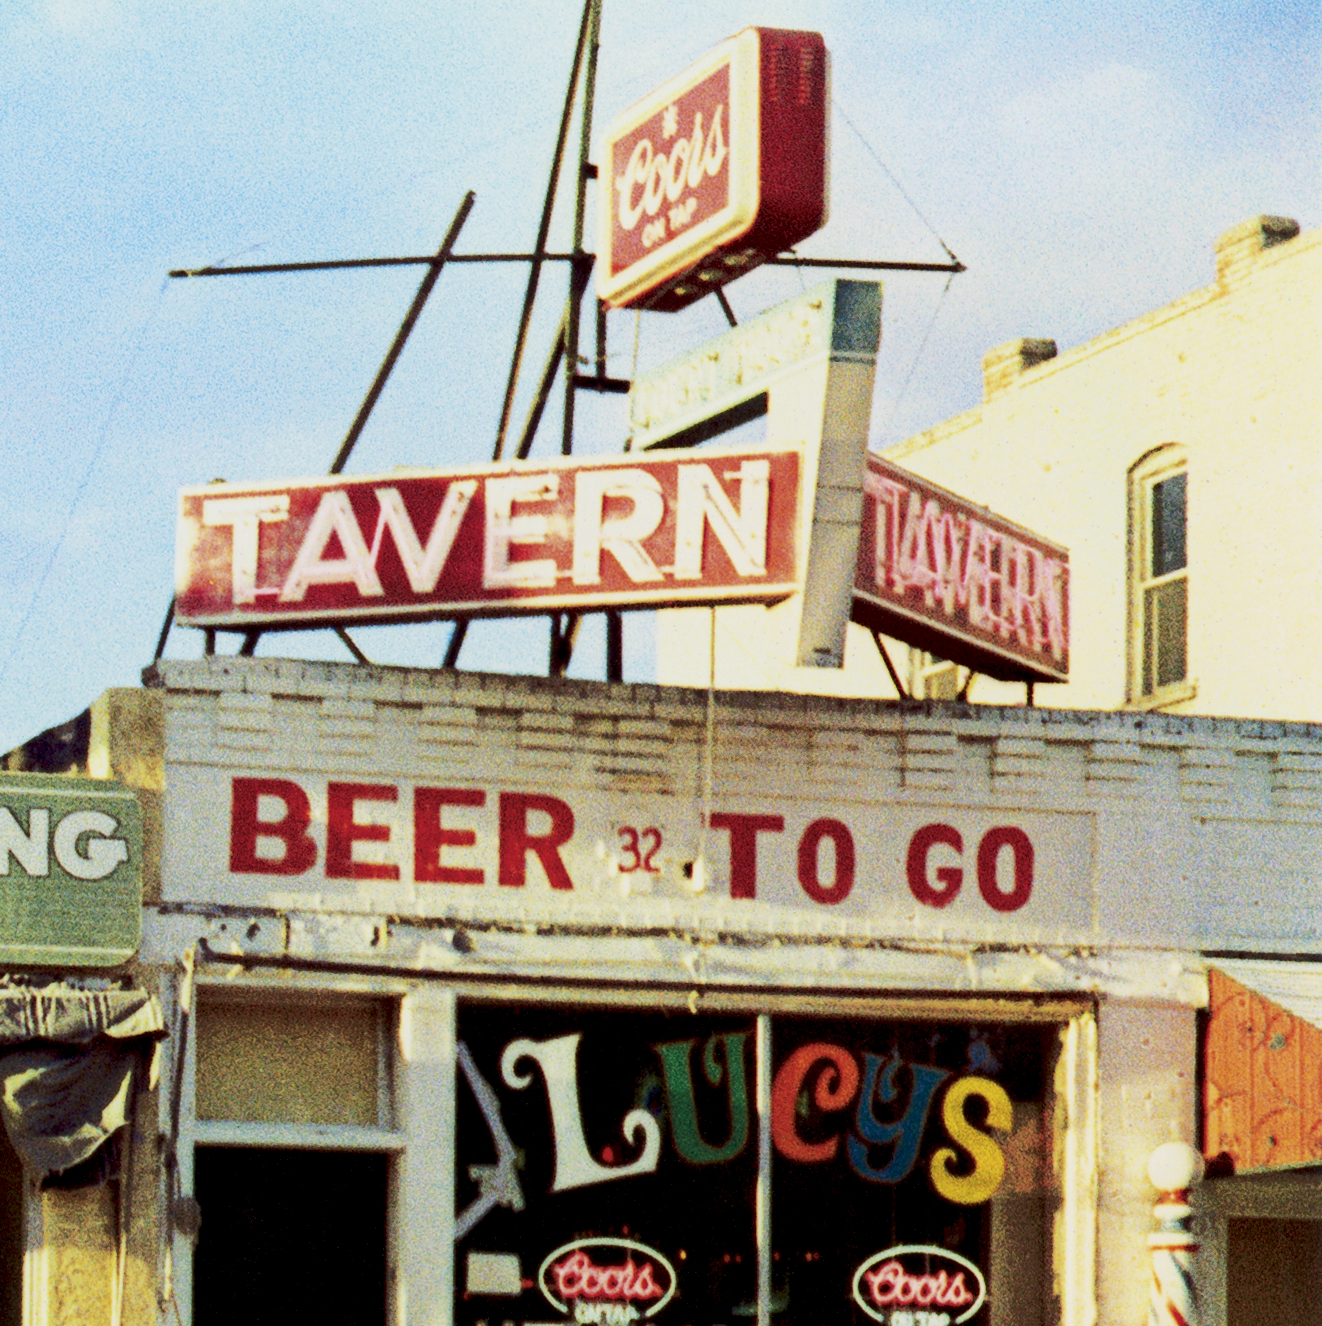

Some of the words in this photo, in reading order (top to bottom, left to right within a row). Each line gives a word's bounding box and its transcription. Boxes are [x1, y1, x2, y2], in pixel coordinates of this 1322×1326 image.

[615, 104, 730, 231] Coors
[642, 216, 665, 248] ON
[667, 196, 698, 231] TAP
[201, 459, 771, 600] TAVERN
[863, 467, 1071, 660] TAVERN
[229, 776, 576, 892] BEER
[617, 825, 663, 874] 32
[708, 811, 857, 906] TO
[905, 822, 1037, 913] GO
[554, 1249, 663, 1299] Coors
[865, 1259, 972, 1306] Coors
